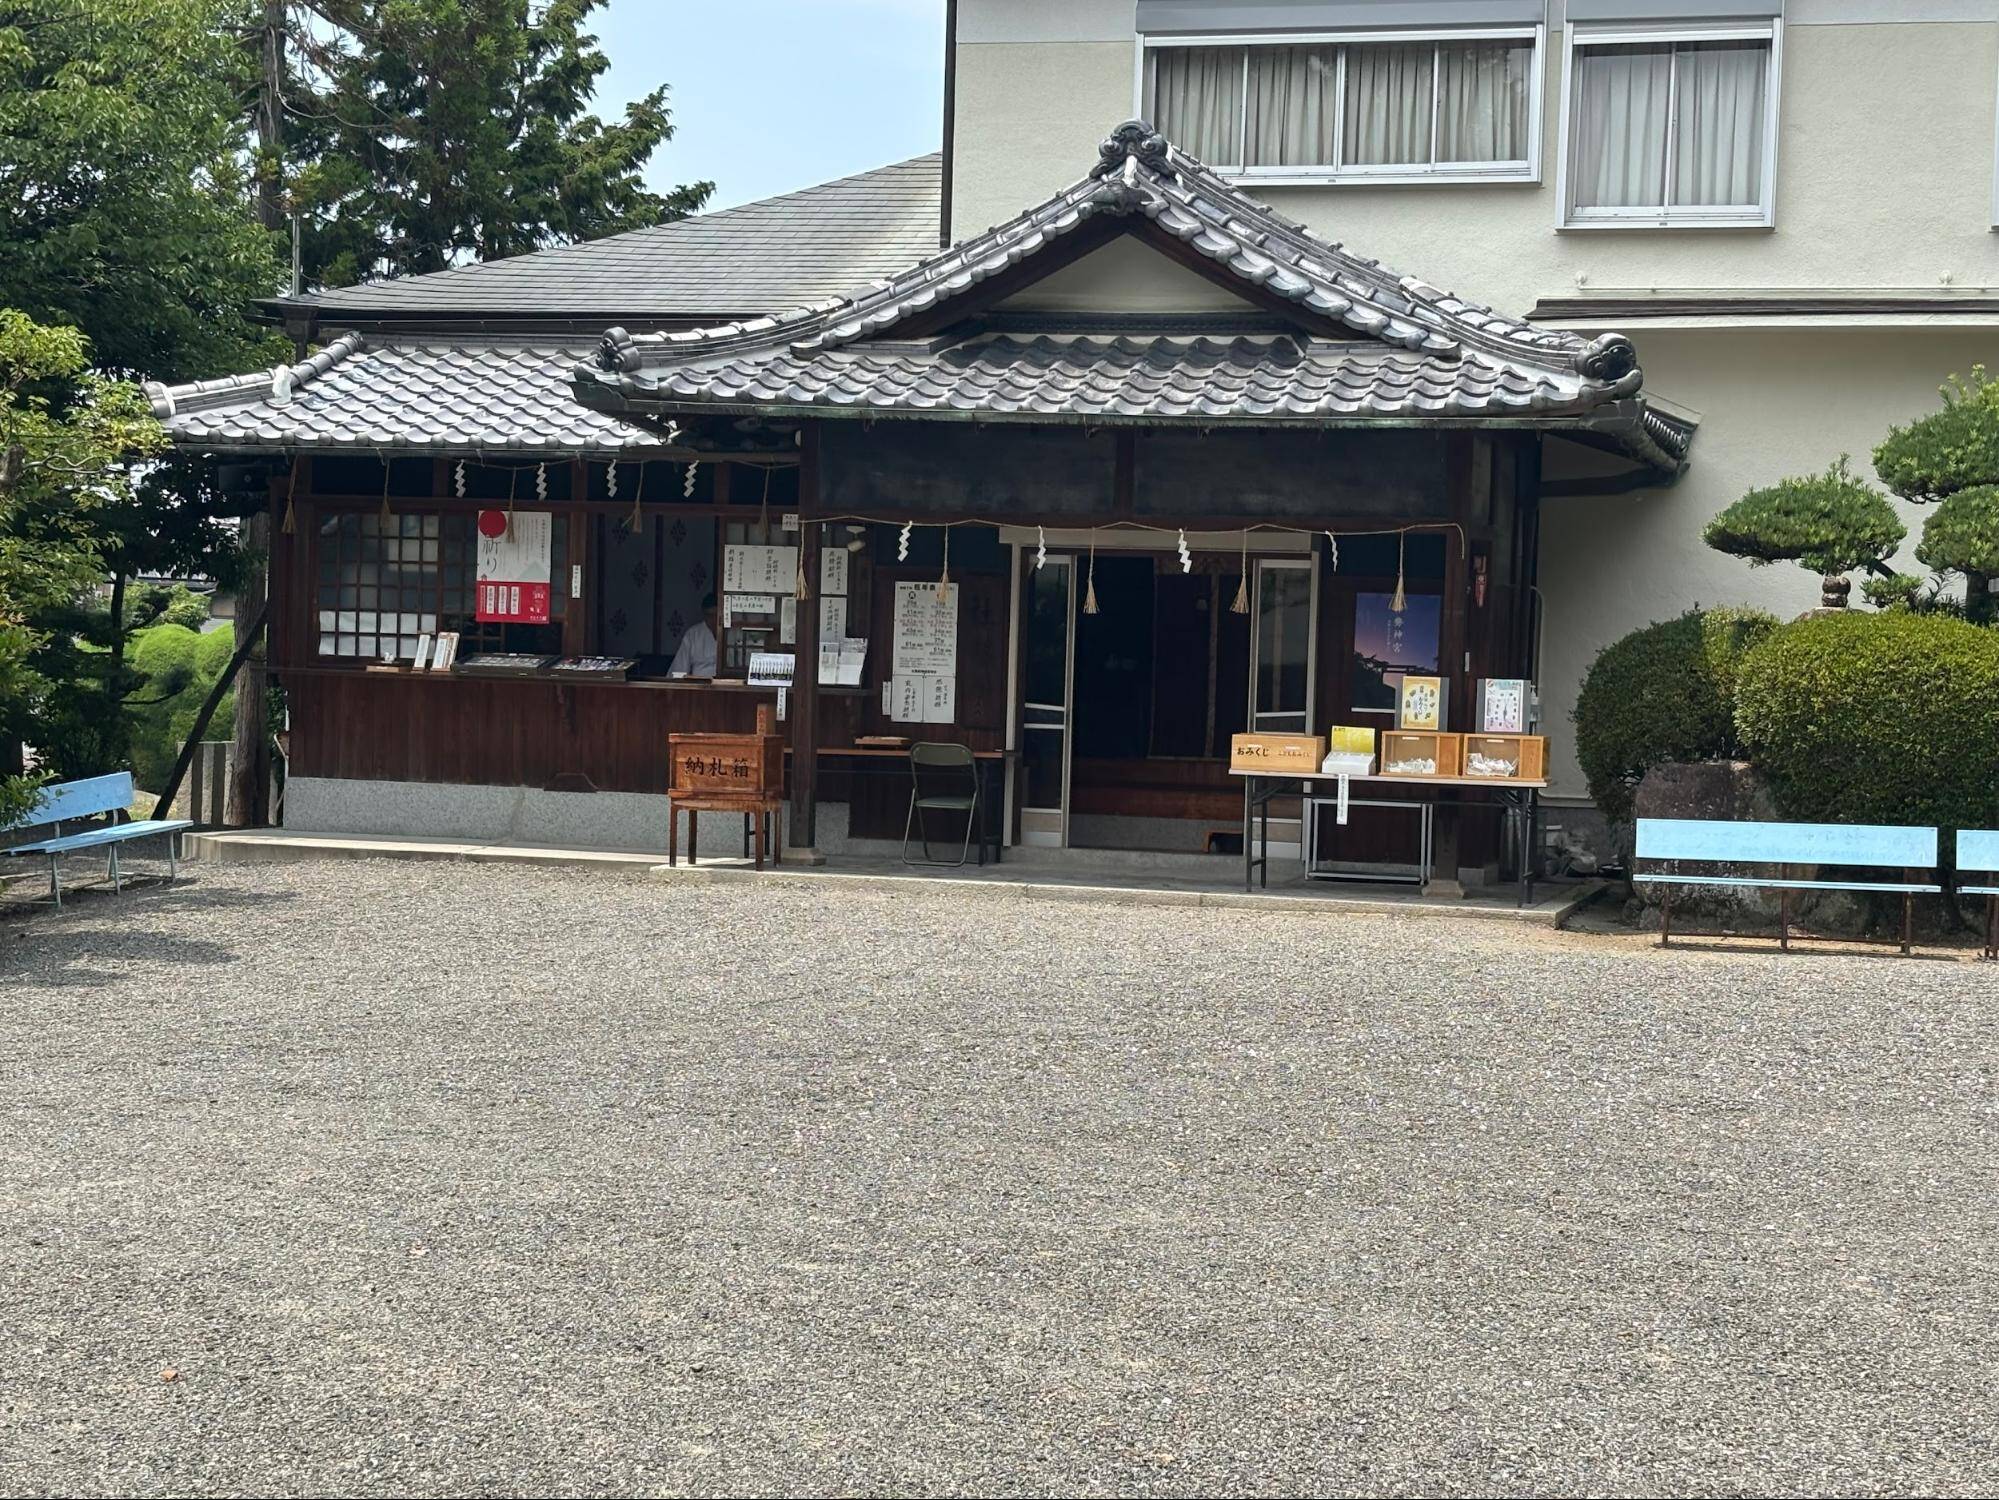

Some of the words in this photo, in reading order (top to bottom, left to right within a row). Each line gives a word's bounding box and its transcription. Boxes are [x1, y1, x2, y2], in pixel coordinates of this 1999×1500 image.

[482, 534, 501, 573] 祈り
[1393, 616, 1404, 654] 勢神宮
[685, 756, 749, 778] 納札箱
[1237, 747, 1269, 757] おみくじ
